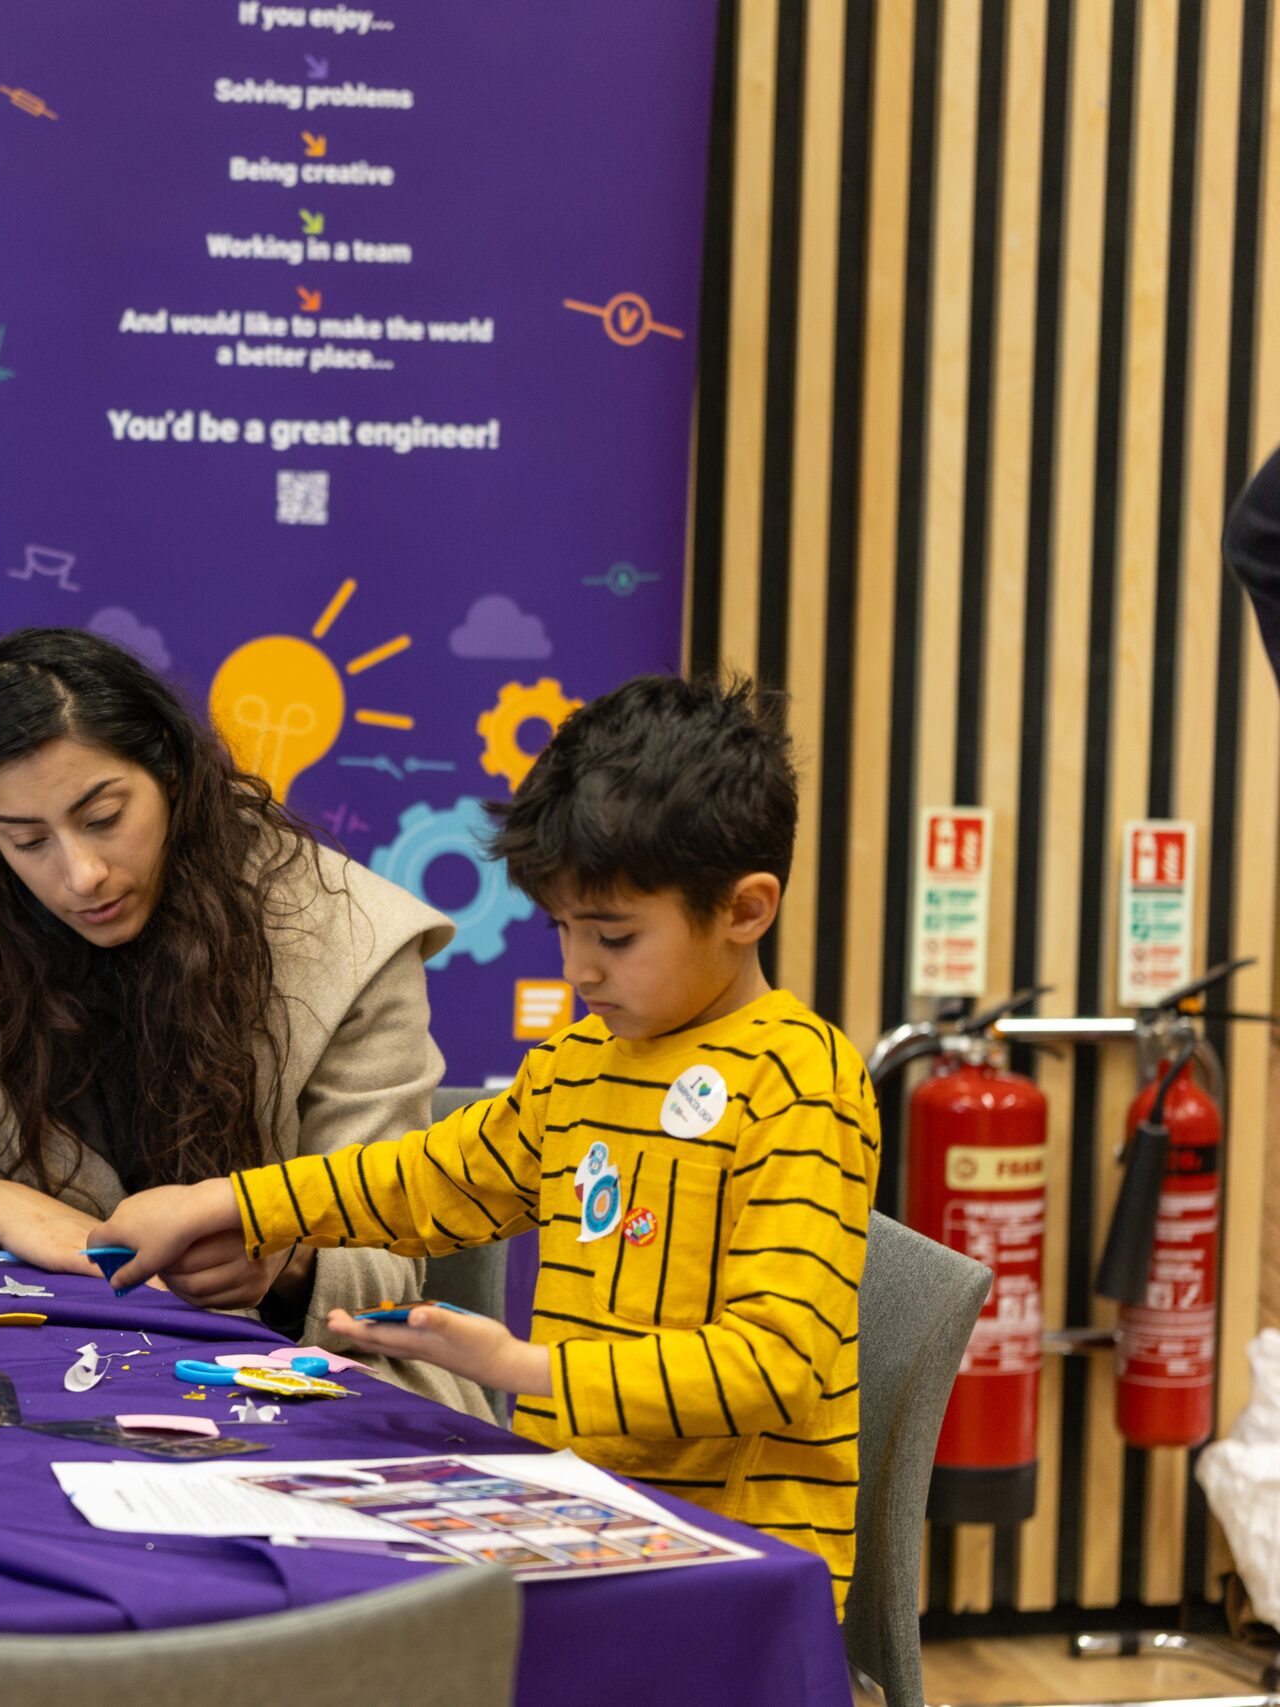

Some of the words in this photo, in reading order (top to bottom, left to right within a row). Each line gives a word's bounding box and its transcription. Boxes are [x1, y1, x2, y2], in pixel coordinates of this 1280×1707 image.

[238, 0, 260, 25] If
[261, 6, 307, 31] you
[308, 5, 395, 35] enjoy...
[214, 78, 303, 110] Solving
[305, 80, 414, 111] problems
[229, 156, 299, 188] Being
[300, 160, 395, 186] creative
[206, 233, 305, 265] Working
[306, 237, 331, 261] in
[333, 243, 350, 262] a
[352, 240, 412, 263] team
[119, 309, 169, 334] And
[170, 309, 242, 336] would
[243, 310, 289, 338] like
[290, 314, 318, 338] to
[319, 314, 384, 341] make
[385, 316, 425, 342] the
[427, 318, 495, 343] world
[216, 345, 234, 367] a
[235, 340, 308, 368] better
[309, 342, 395, 374] place...
[107, 410, 194, 442] You'd
[198, 411, 240, 444] be
[243, 419, 266, 445] a
[269, 416, 351, 451] great
[354, 415, 501, 455] engineer!
